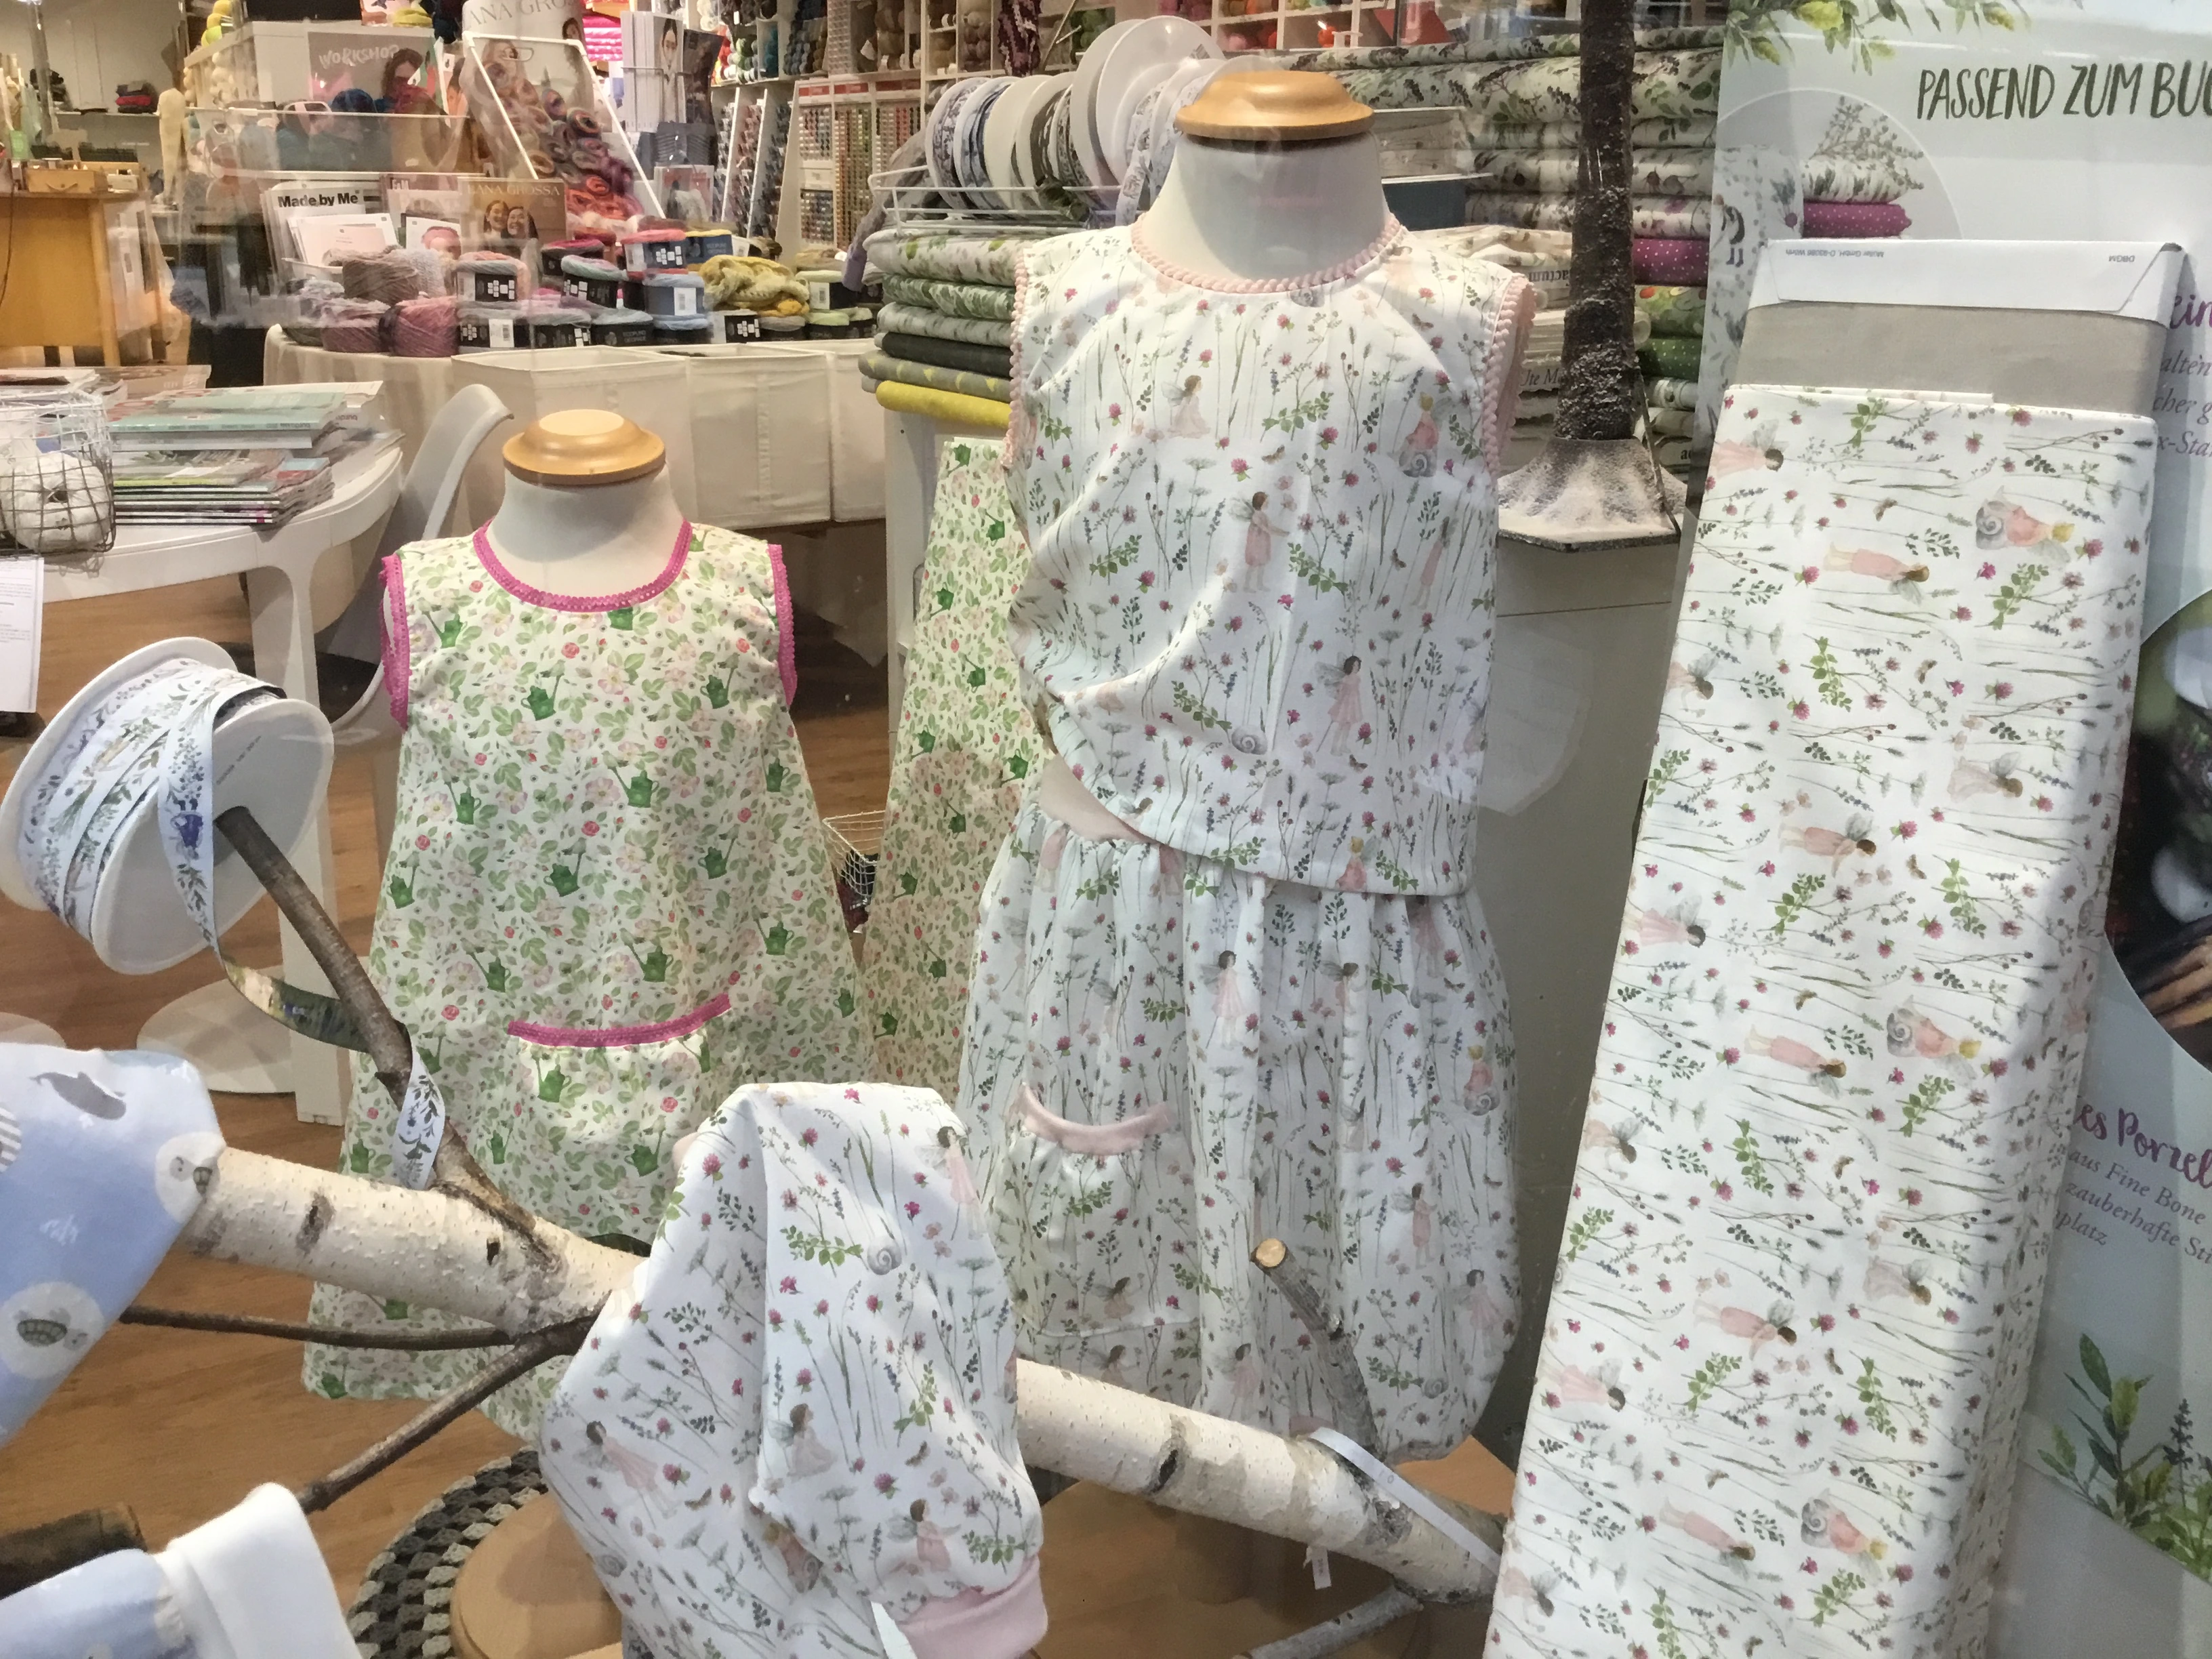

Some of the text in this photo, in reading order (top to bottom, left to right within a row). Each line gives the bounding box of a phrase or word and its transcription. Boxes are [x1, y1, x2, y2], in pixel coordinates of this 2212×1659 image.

[1917, 63, 2055, 121] PASSEND
[2063, 62, 2143, 118] ZUM
[277, 192, 359, 208] Made by Me
[468, 184, 560, 196] LANA GROSSA
[2066, 1182, 2180, 1246] zauberhafte
[2068, 1150, 2207, 1225] aus Fine Bone
